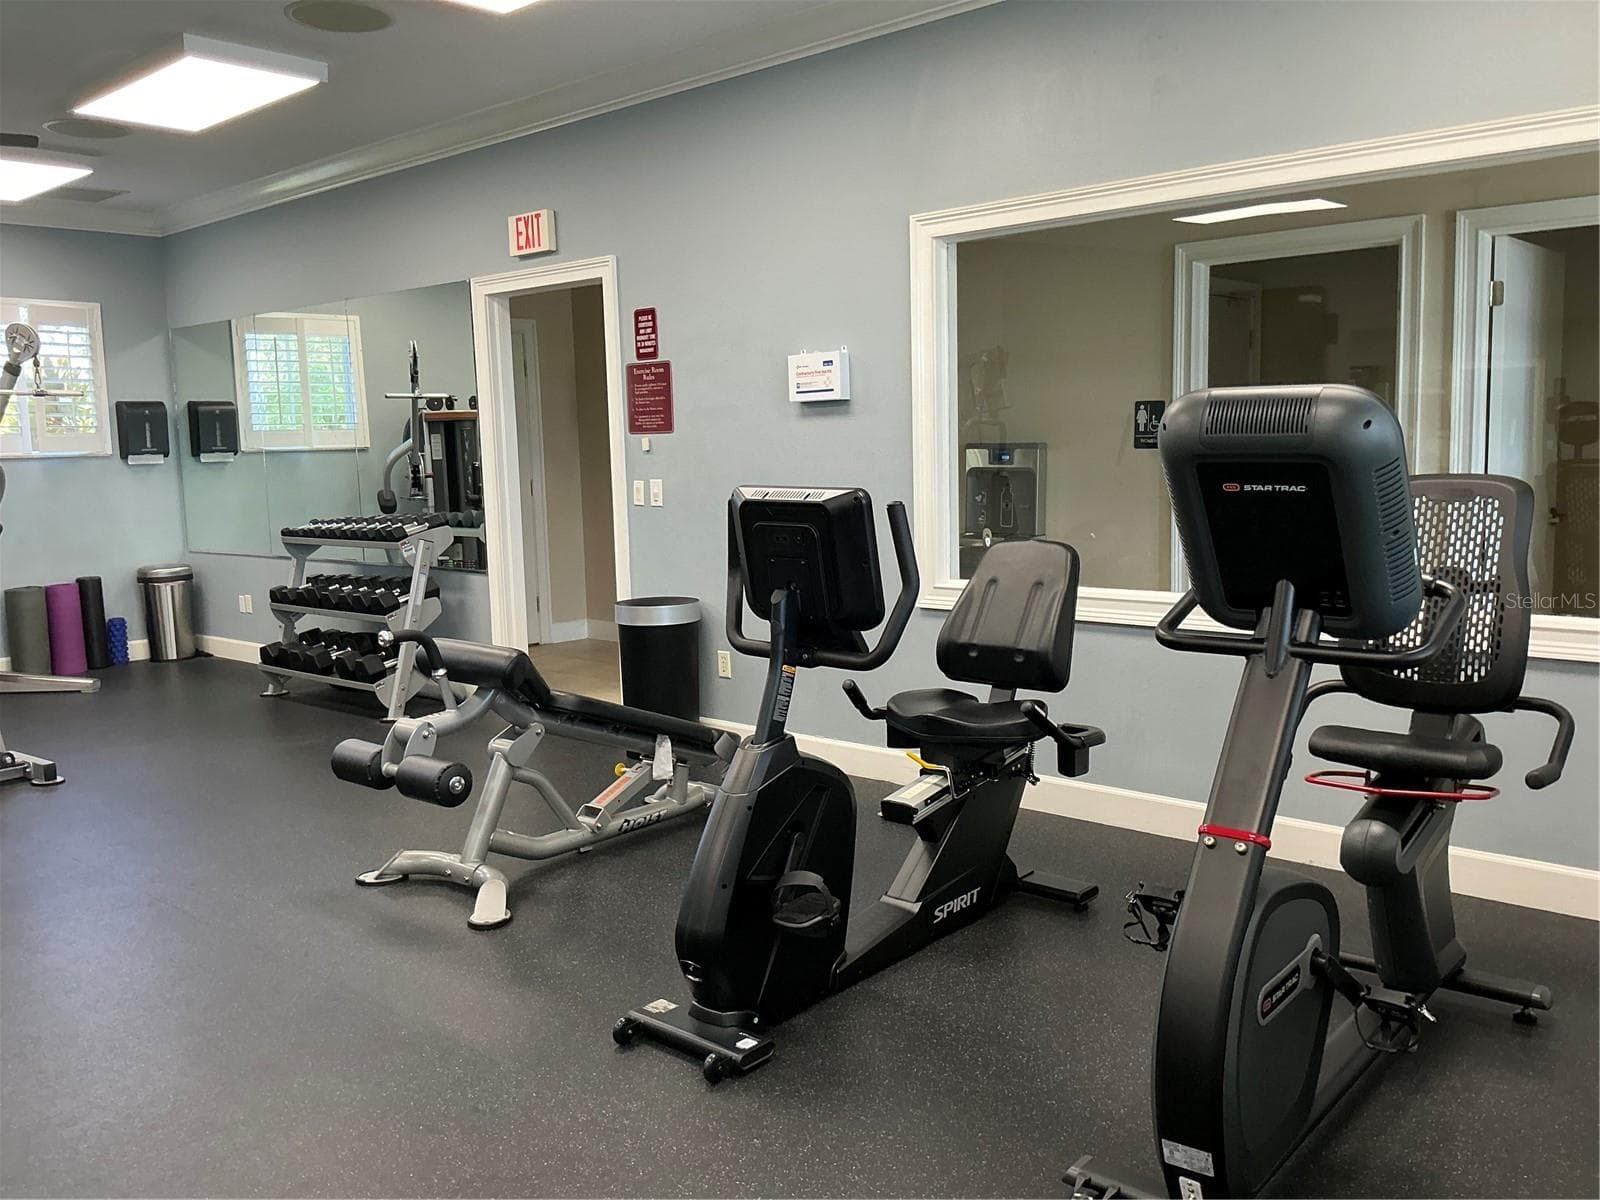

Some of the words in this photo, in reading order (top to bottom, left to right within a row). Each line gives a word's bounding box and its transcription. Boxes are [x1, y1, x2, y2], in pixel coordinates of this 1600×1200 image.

[515, 213, 542, 251] EXIT
[1243, 484, 1273, 492] STAR
[1273, 485, 1306, 493] TRAC
[618, 810, 668, 832] HOIST
[933, 887, 981, 924] SPIRIT
